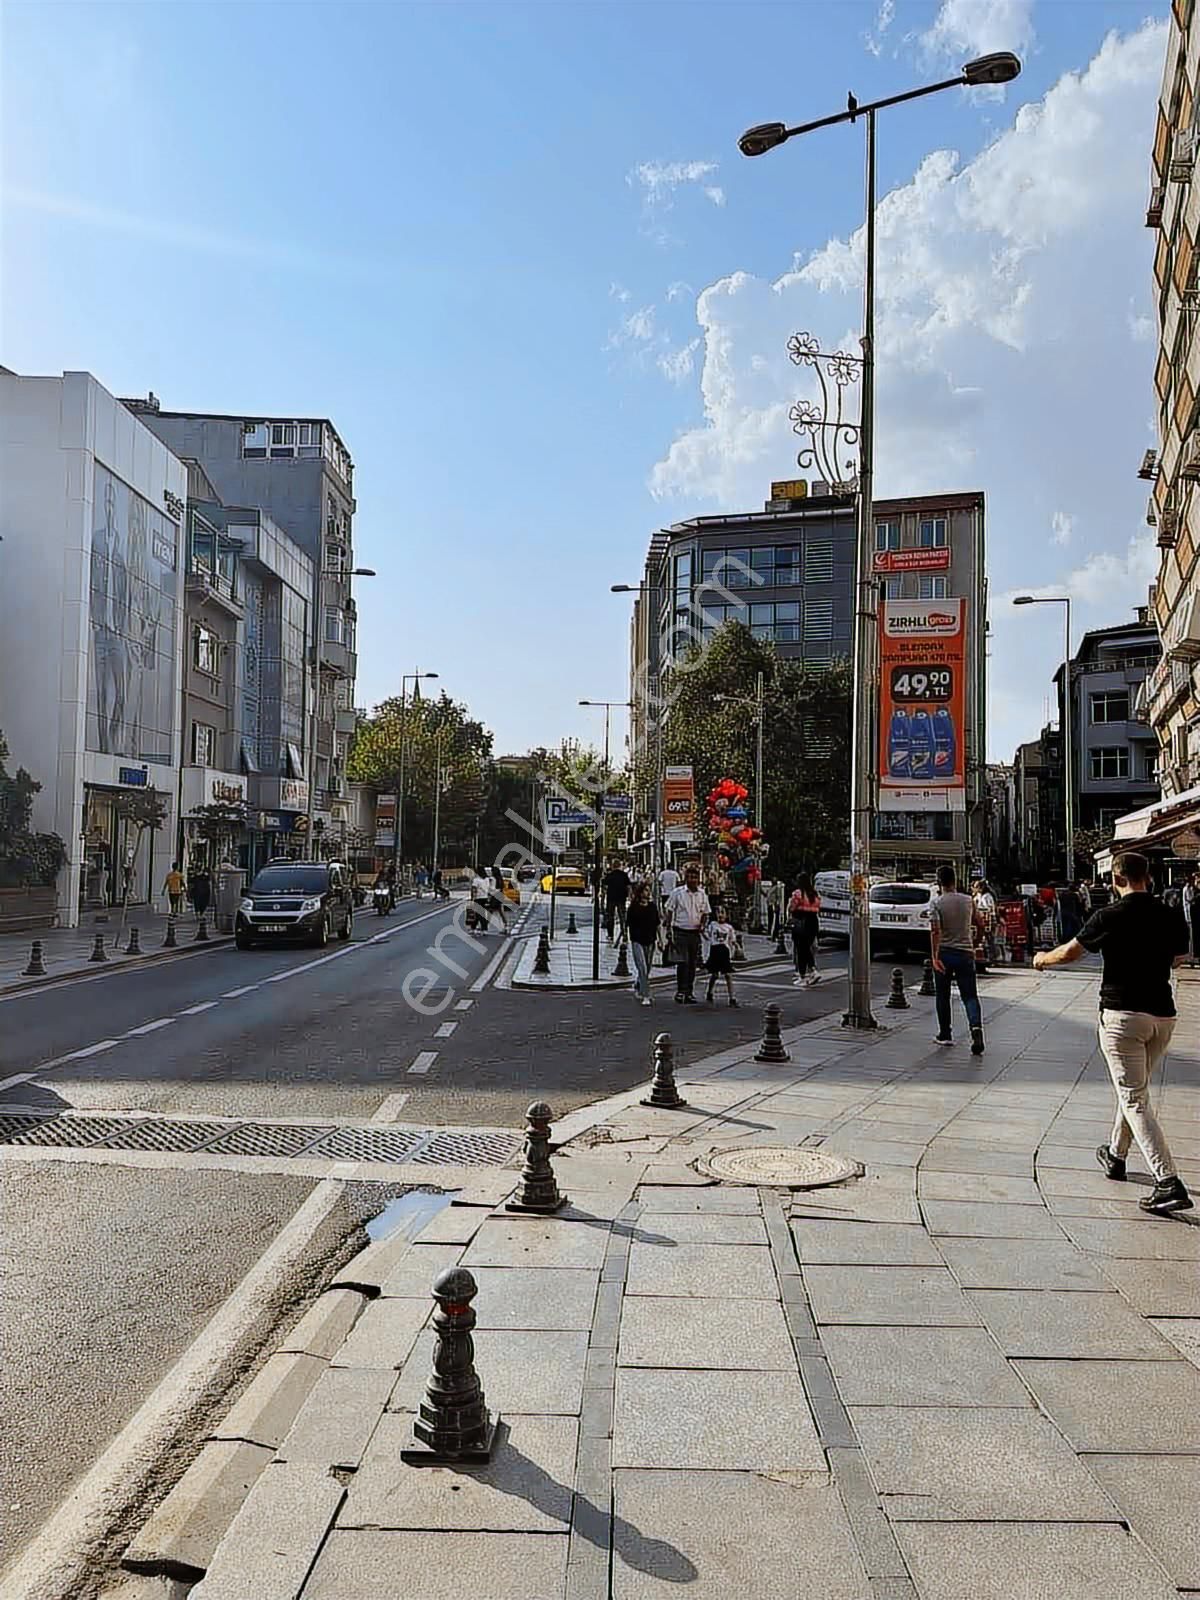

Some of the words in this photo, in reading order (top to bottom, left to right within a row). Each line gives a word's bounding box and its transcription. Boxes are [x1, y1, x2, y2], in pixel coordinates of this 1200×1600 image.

[888, 616, 927, 628] ZIRHLI
[929, 671, 950, 685] 90
[933, 687, 948, 696] TL
